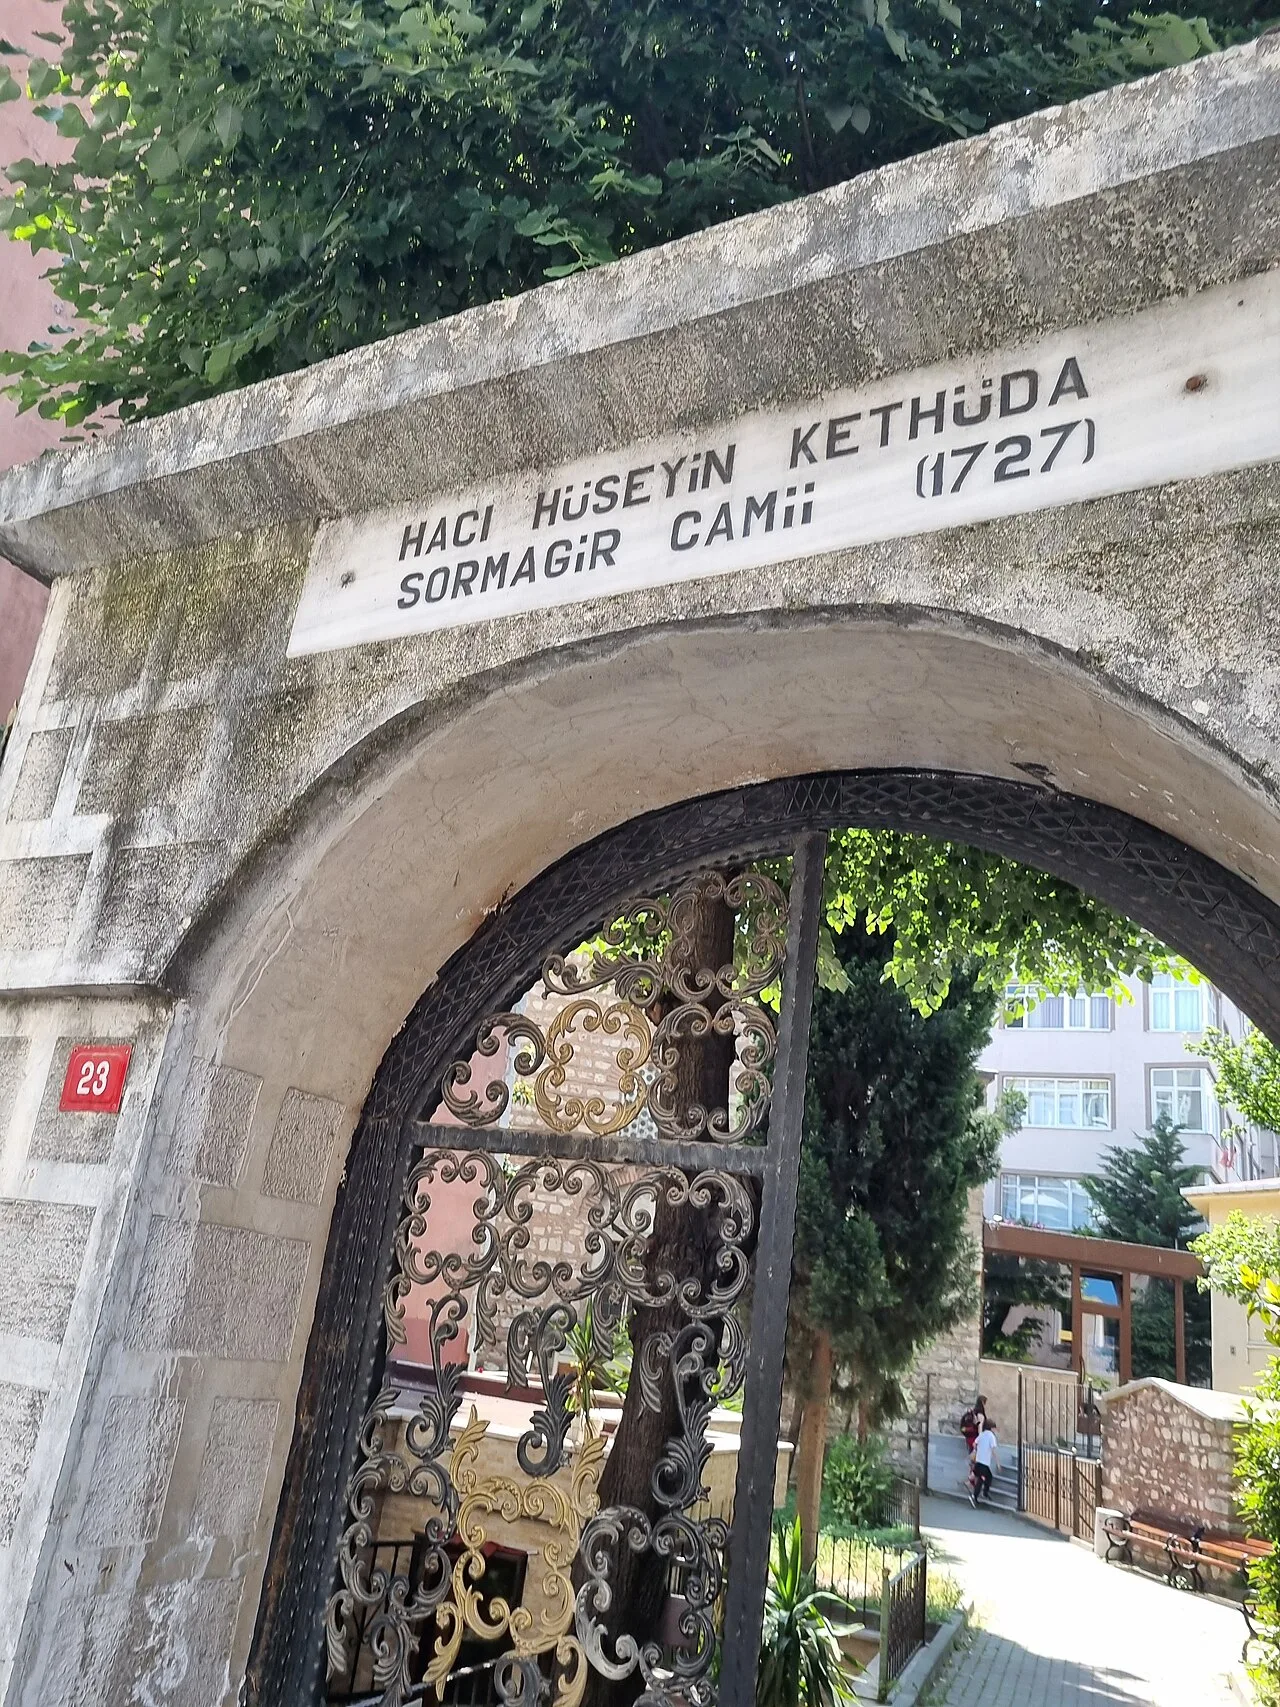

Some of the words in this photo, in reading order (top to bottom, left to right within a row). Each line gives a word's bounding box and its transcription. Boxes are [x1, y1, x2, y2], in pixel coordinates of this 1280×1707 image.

[397, 528, 621, 609] SORMAGİR
[915, 418, 1096, 499] (1727)
[398, 504, 494, 561] HACI
[531, 444, 737, 530] HÜSEYİN
[788, 356, 1090, 469] KETHÜDA
[76, 1060, 110, 1096] 23
